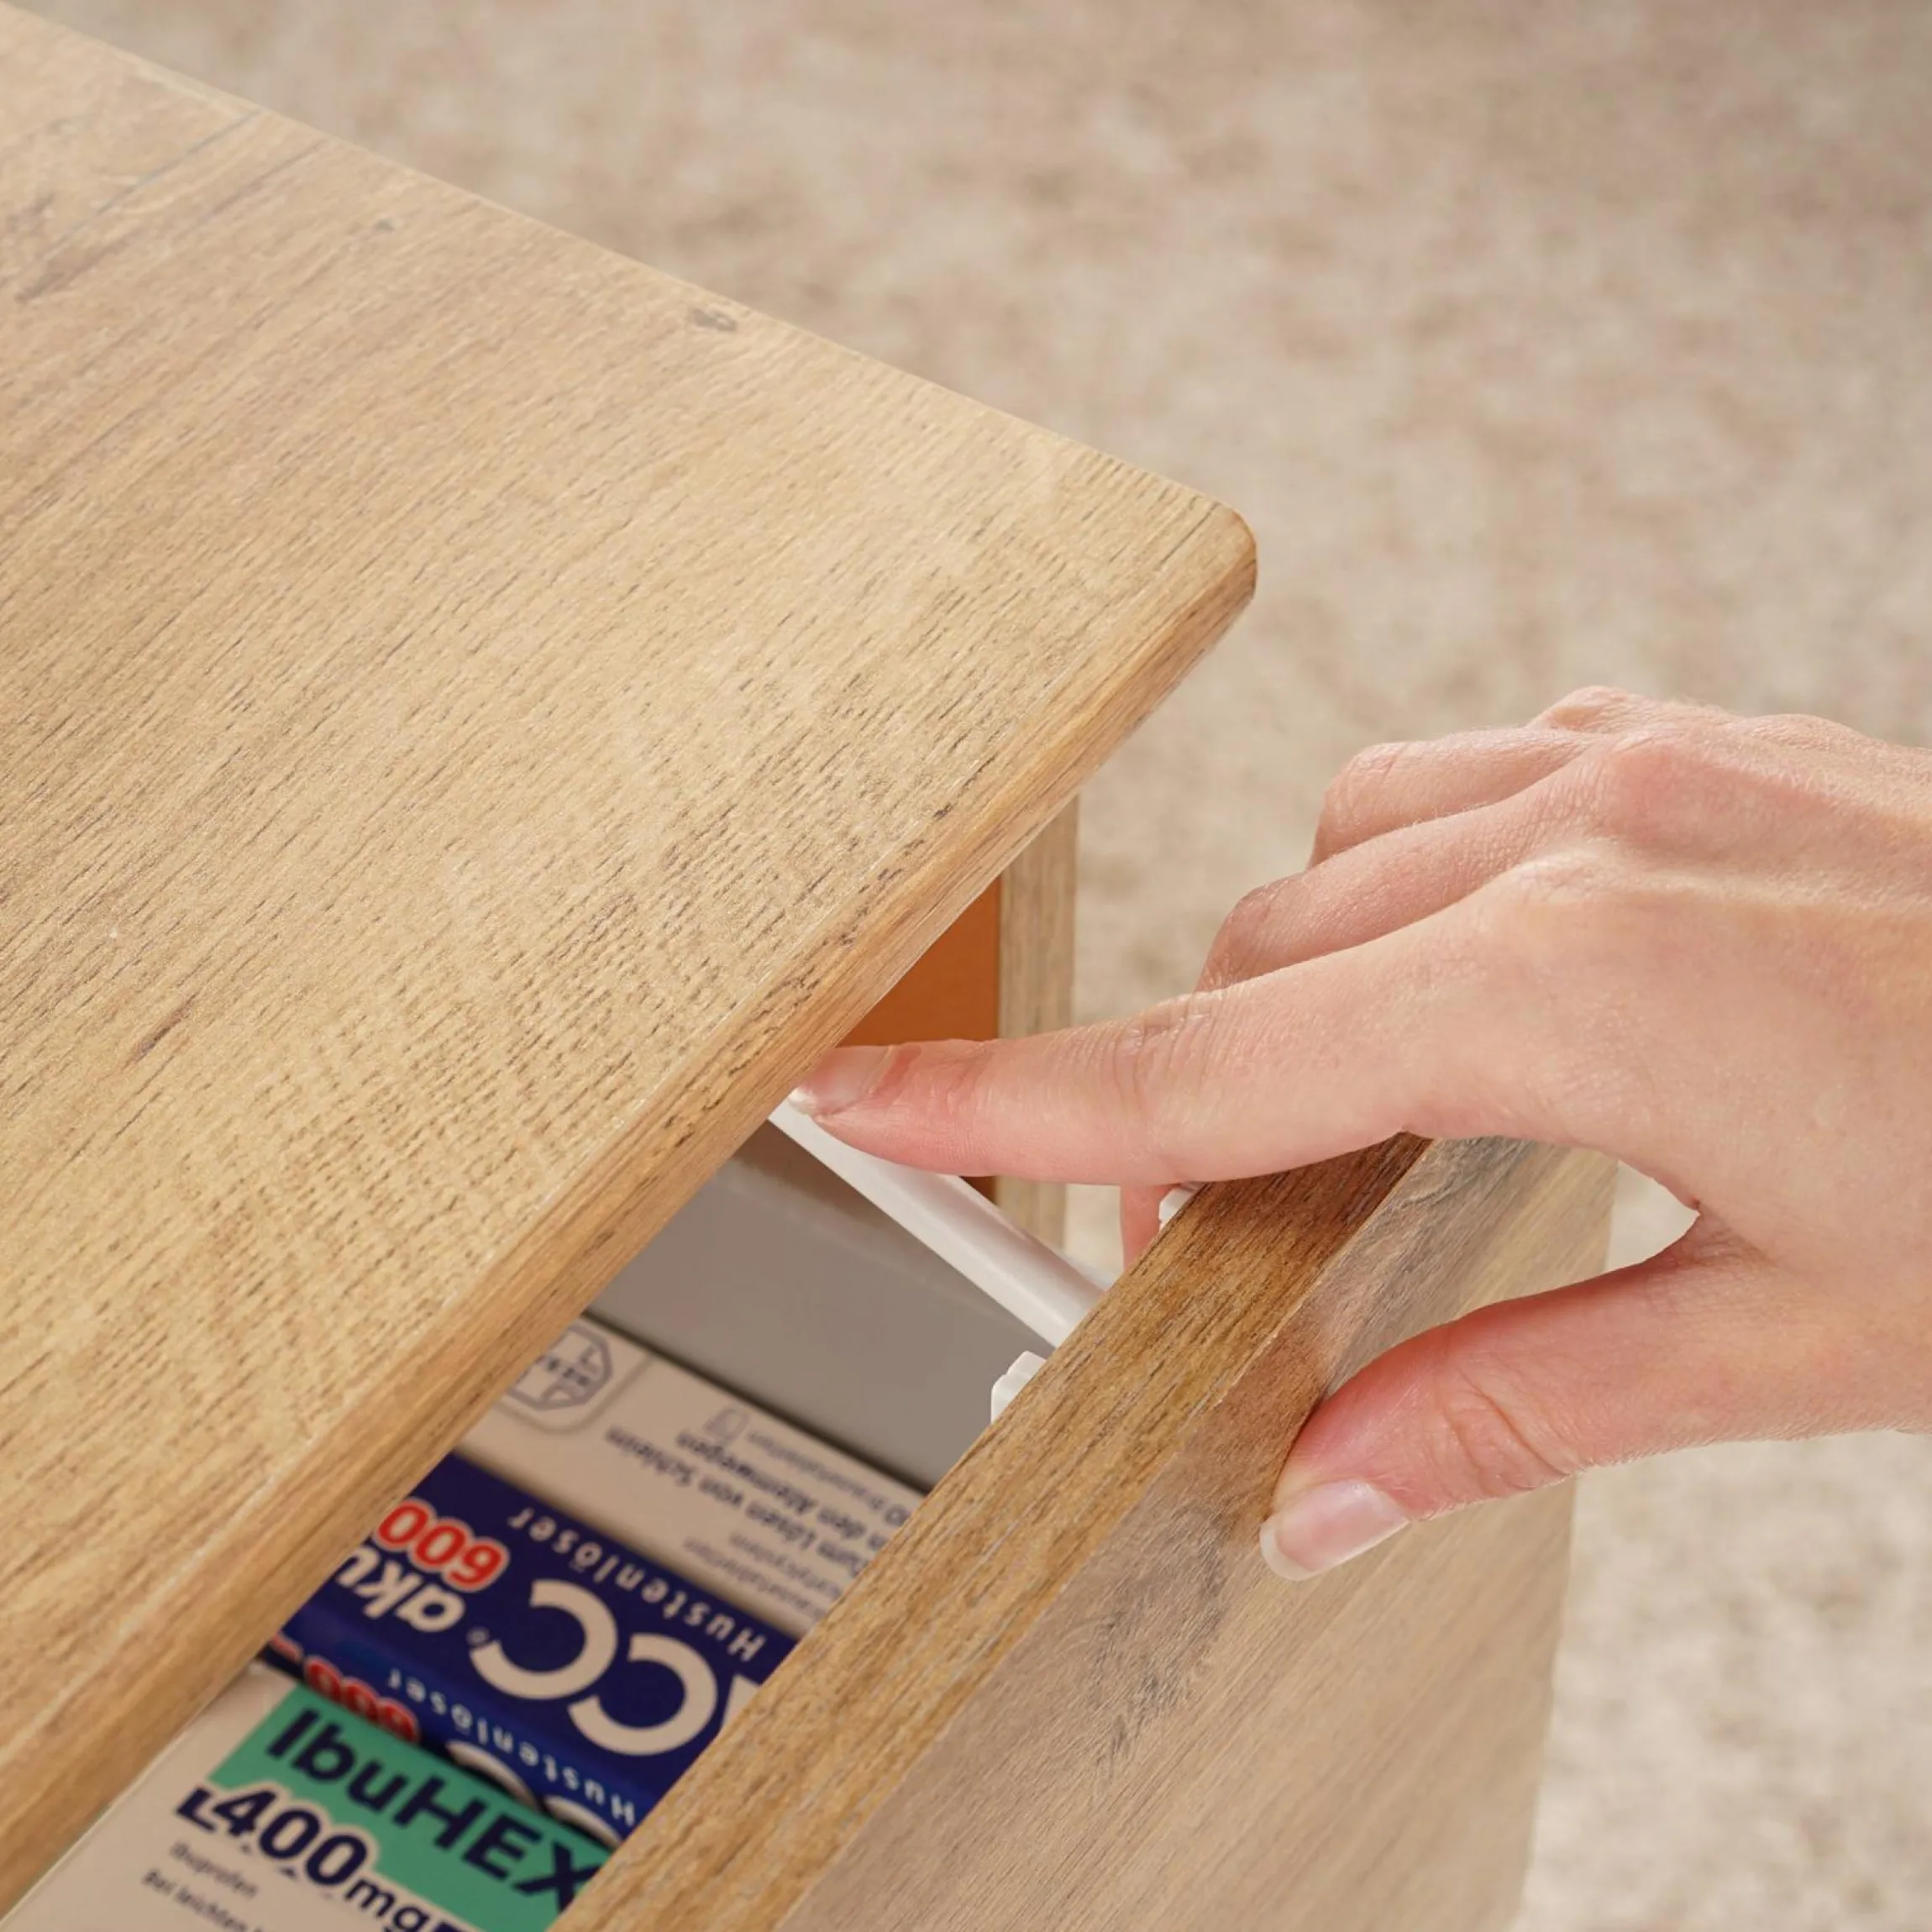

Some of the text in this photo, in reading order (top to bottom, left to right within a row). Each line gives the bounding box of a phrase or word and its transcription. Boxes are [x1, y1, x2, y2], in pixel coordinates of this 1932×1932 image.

[375, 1501, 507, 1590] 600
[508, 1507, 768, 1662] Hustenlöser
[389, 1669, 636, 1827] Hustenlöser
